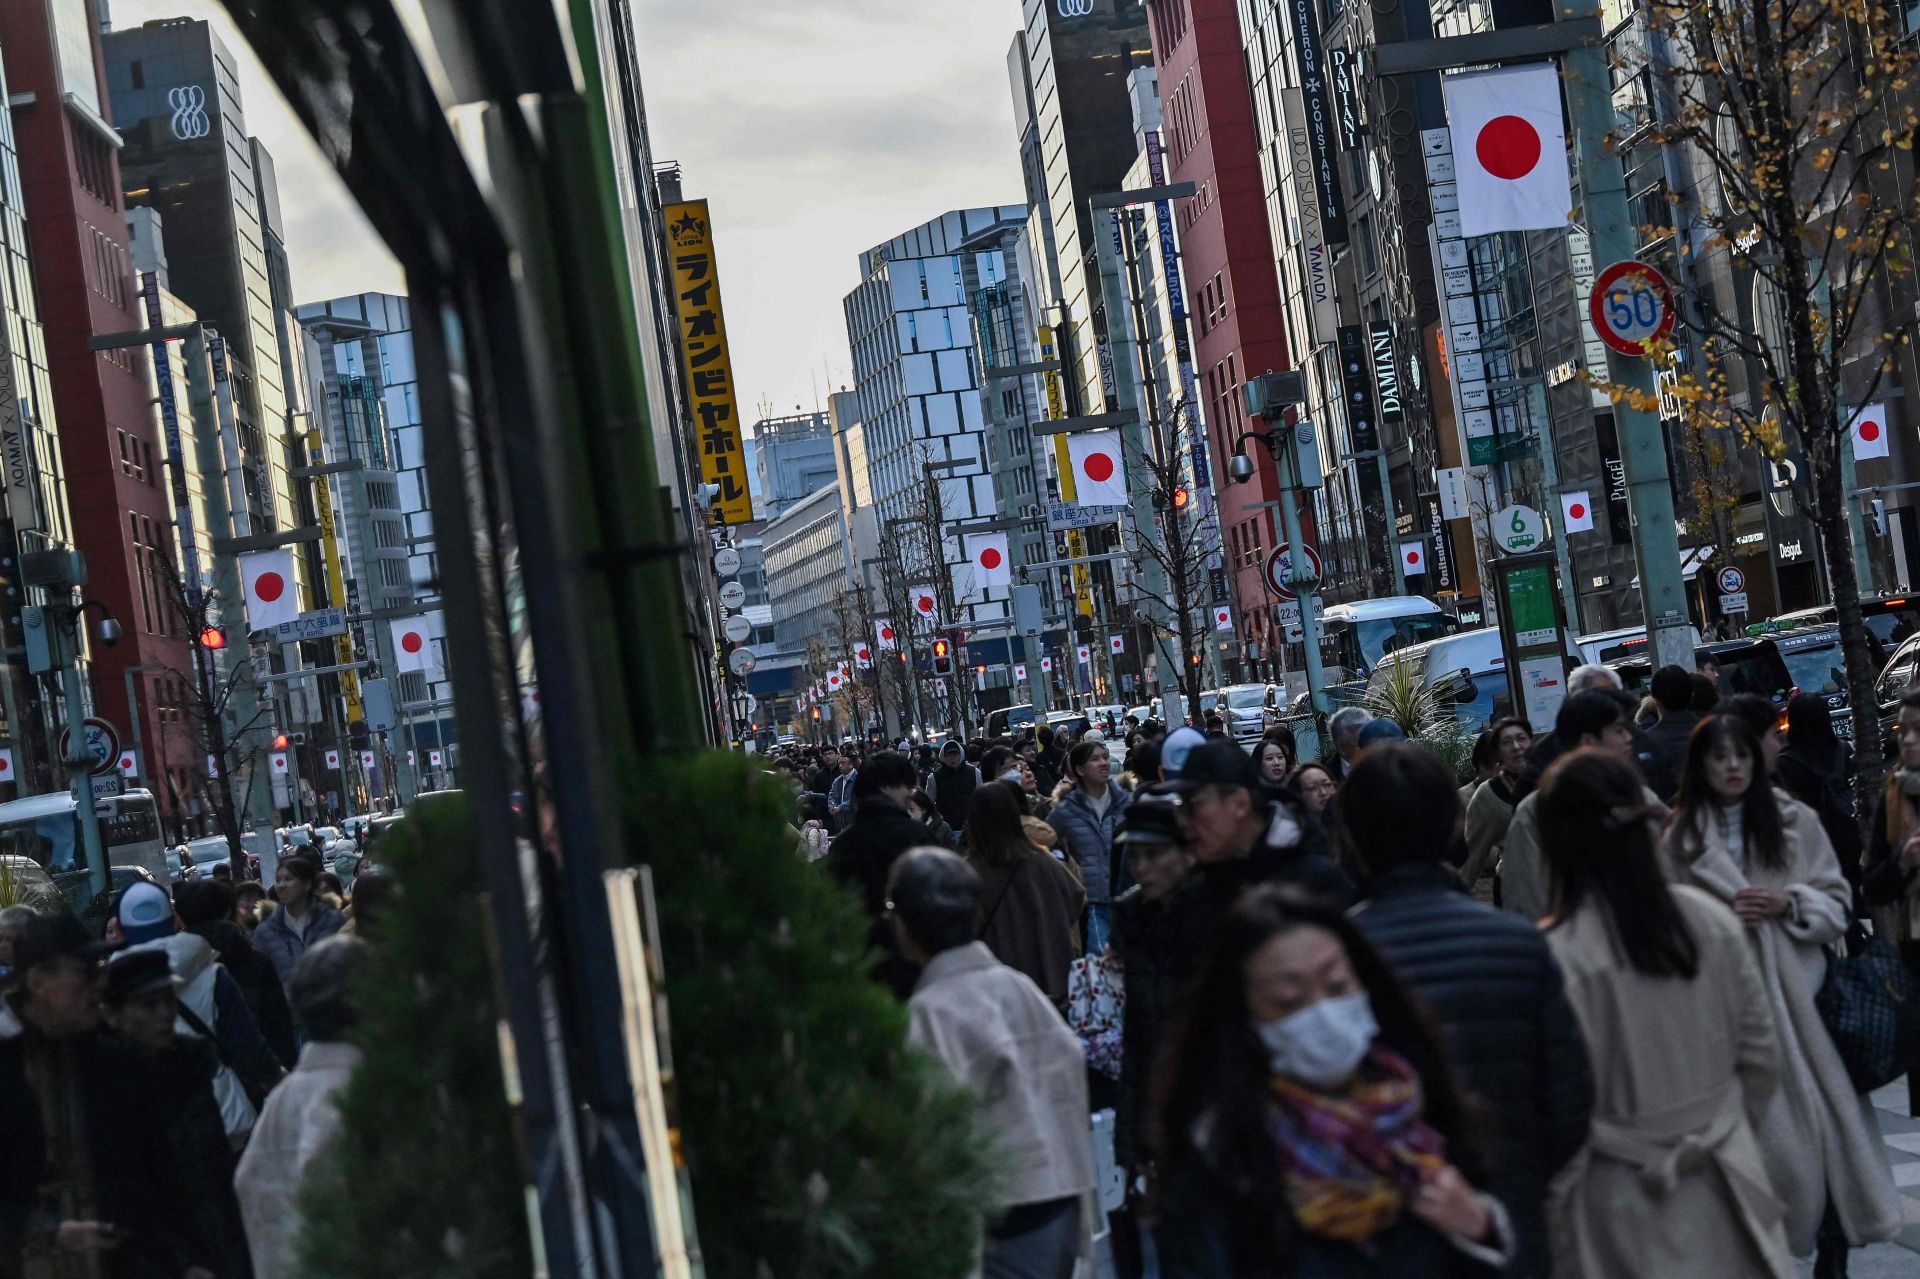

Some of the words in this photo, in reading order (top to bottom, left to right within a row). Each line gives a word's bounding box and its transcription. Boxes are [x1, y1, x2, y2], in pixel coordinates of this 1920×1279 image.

[1333, 51, 1355, 146] DAMIANI
[1312, 98, 1337, 218] CONSTANTIN
[677, 239, 703, 247] LION
[1297, 159, 1318, 226] OTSUKA
[1310, 243, 1327, 303] YAMADA
[1609, 288, 1656, 329] 50
[676, 253, 744, 504] ライオンビヤホール
[1372, 330, 1400, 414] DAMIANI
[1605, 458, 1626, 500] PIAGET
[1051, 506, 1114, 523] 銀座六丁目
[1071, 517, 1088, 526] Ginza
[1091, 515, 1097, 523] 6
[1511, 510, 1525, 533] 6
[1779, 539, 1802, 560] Desigual
[722, 592, 744, 601] TISSOT
